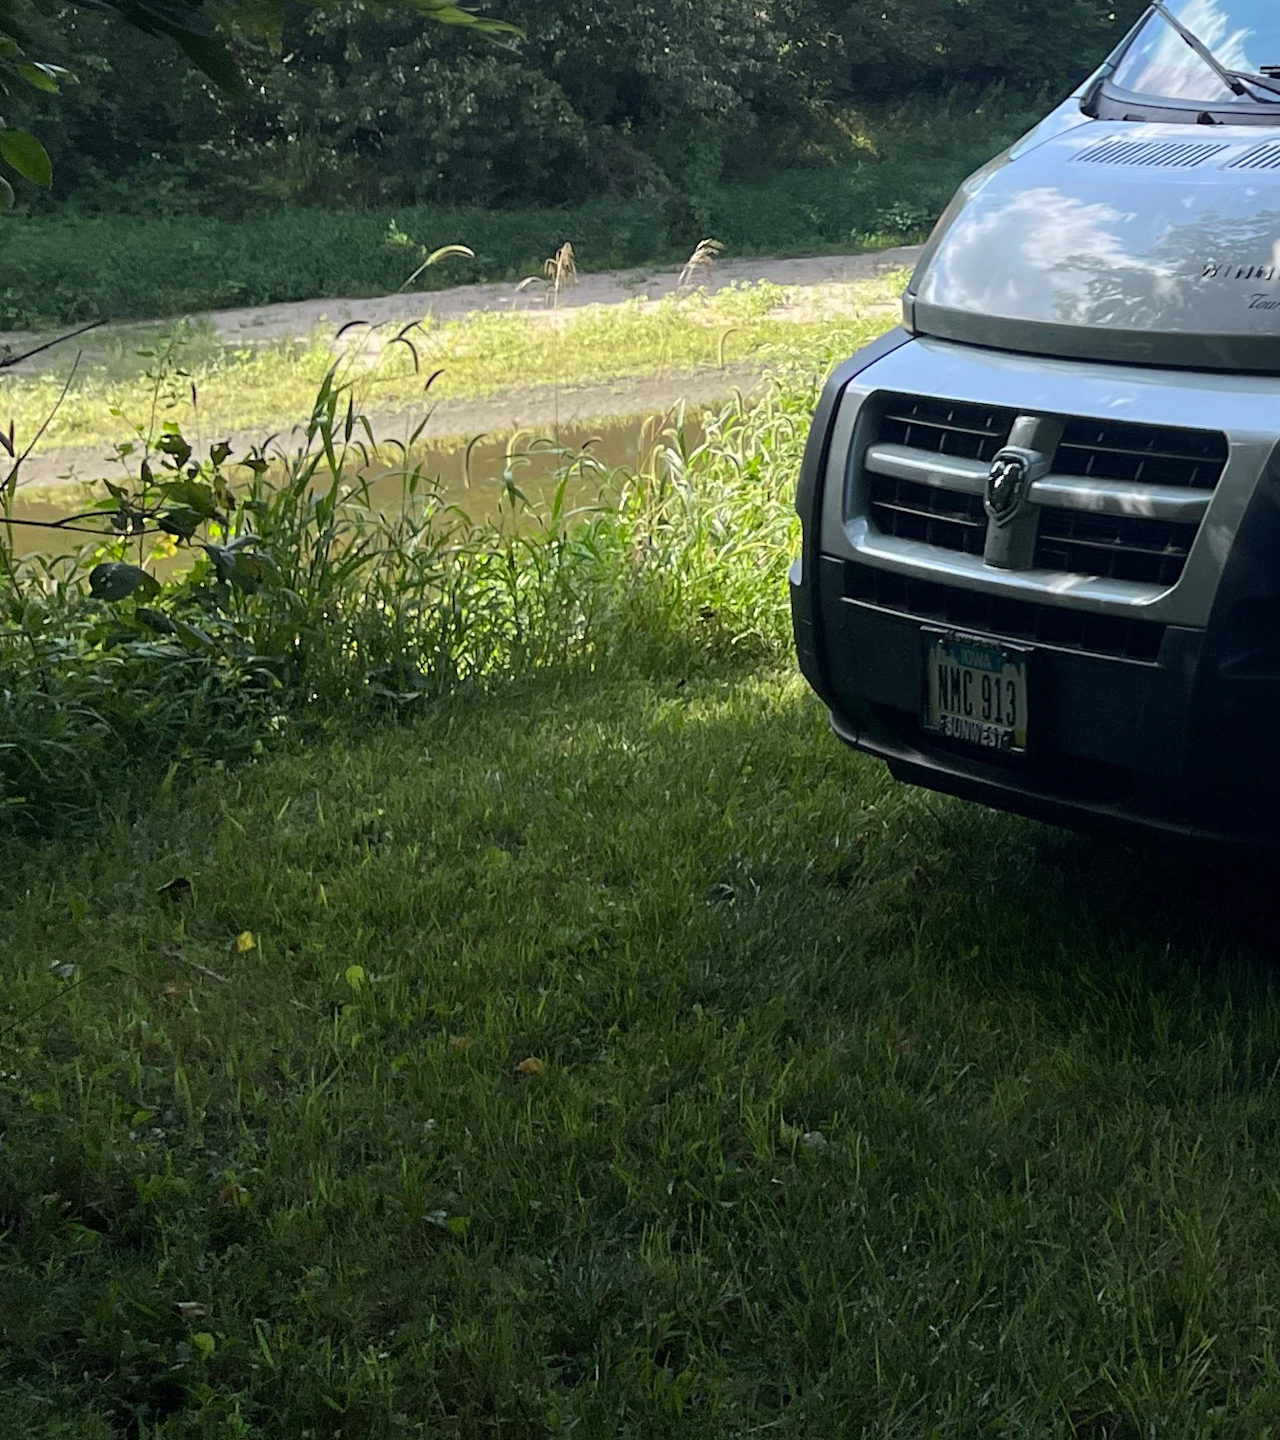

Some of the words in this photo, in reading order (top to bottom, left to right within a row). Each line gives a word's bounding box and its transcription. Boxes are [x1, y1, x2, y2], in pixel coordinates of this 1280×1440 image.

[960, 648, 992, 670] IOWA
[938, 664, 973, 716] NMC
[982, 674, 1016, 727] 913
